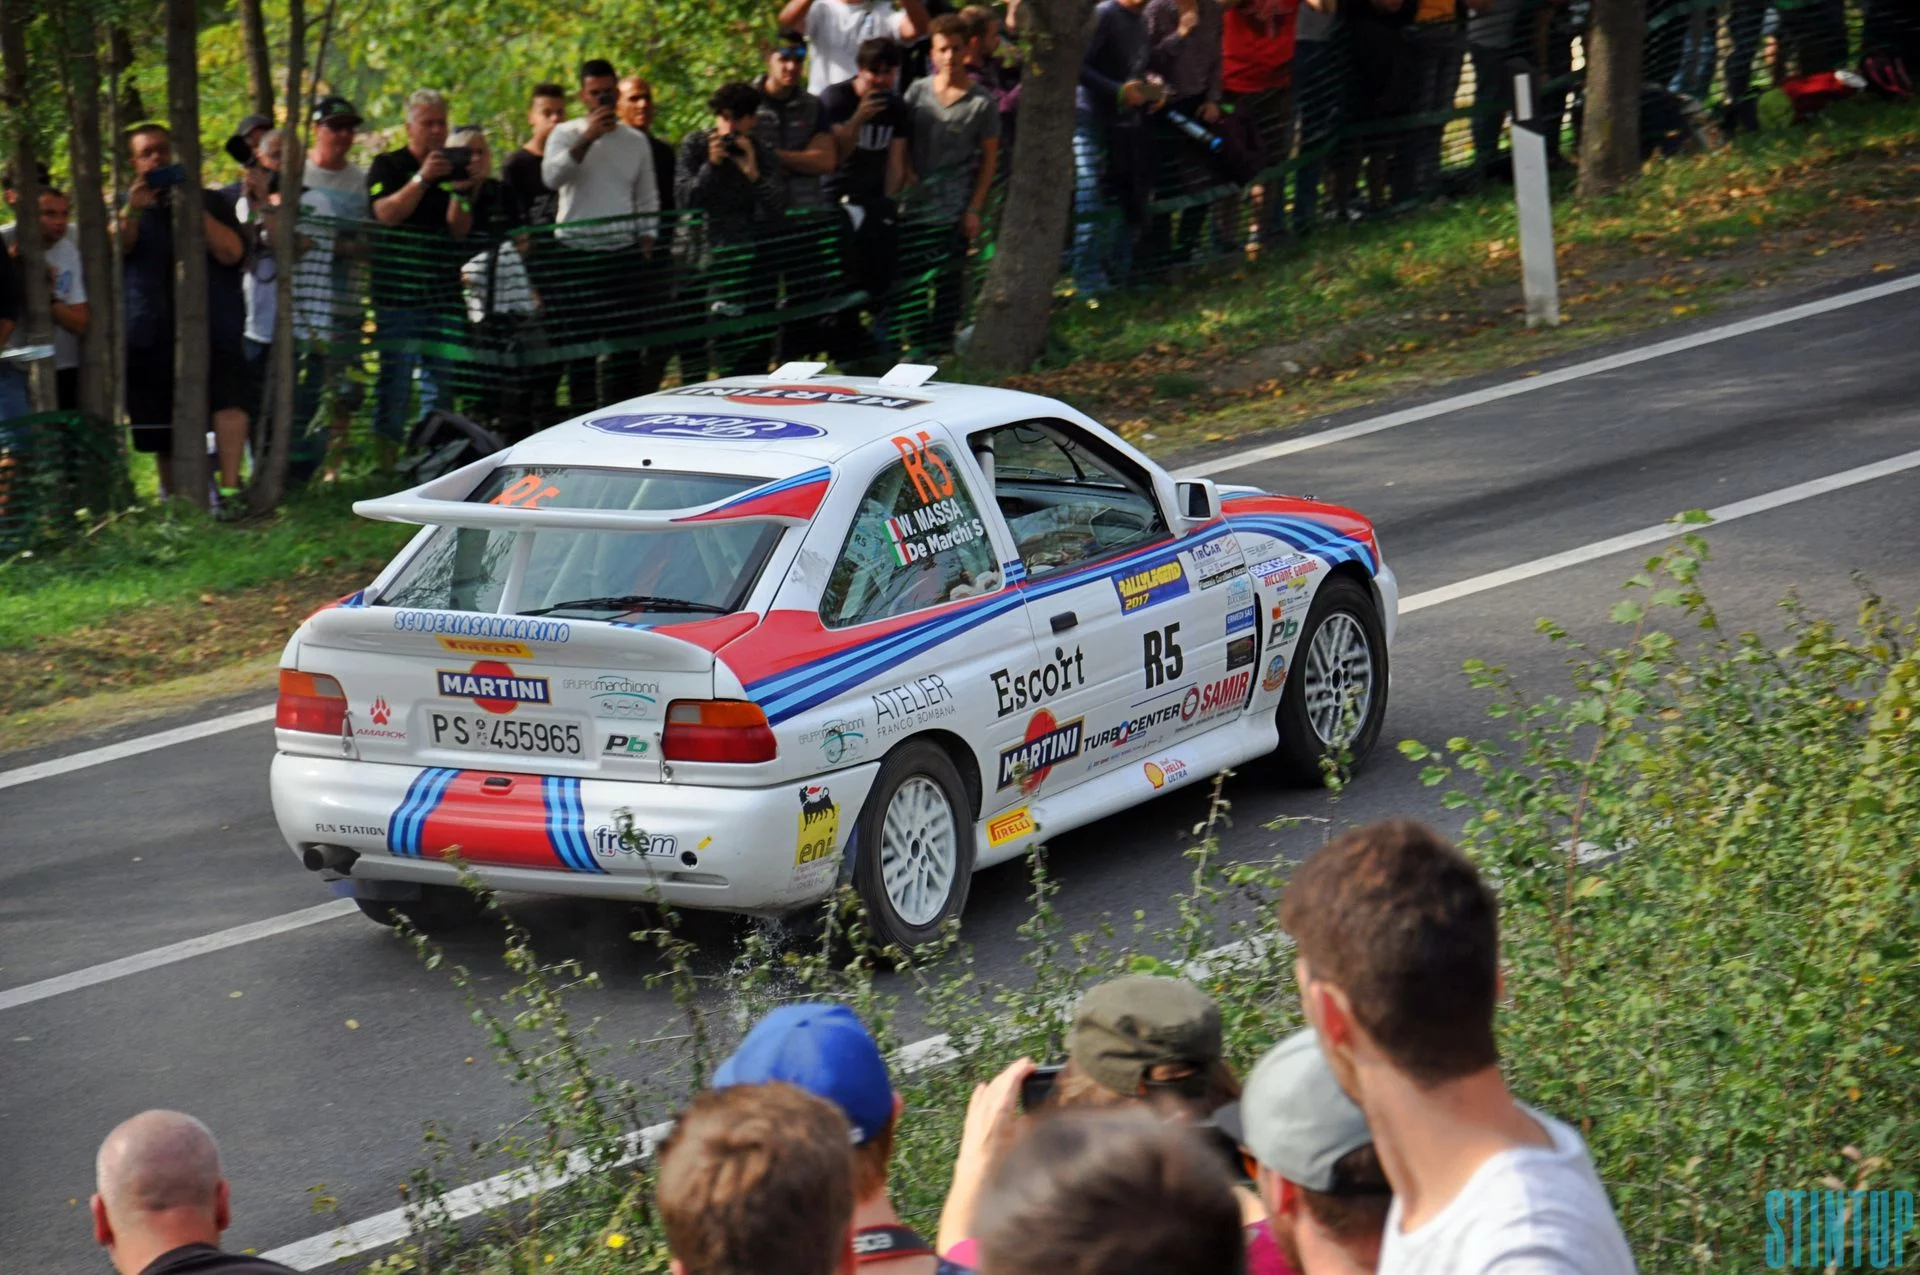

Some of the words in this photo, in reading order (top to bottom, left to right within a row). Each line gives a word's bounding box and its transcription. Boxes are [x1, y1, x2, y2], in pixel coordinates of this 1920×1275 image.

[680, 386, 910, 407] MARTINI
[625, 414, 789, 438] Ford
[891, 431, 954, 504] R5
[895, 514, 917, 538] W.
[913, 498, 964, 532] MASSA
[905, 541, 928, 562] De
[927, 521, 974, 555] Marchi
[971, 518, 984, 538] S
[1124, 593, 1150, 611] 2017
[394, 611, 570, 643] SCUDERIASANMARINO
[1267, 618, 1299, 646] Pb
[1143, 621, 1183, 690] R5
[442, 674, 544, 700] MARTINI
[990, 644, 1085, 718] Escort
[1201, 671, 1249, 712] SAMIR
[871, 674, 953, 725] ATELIER
[356, 728, 407, 740] AMAROK
[432, 714, 470, 745] PS
[490, 720, 580, 755] 455965
[876, 717, 914, 739] FRANCO
[916, 704, 957, 724] BOMBANA
[606, 734, 649, 754] Pb
[1002, 726, 1079, 783] MARTINI
[315, 823, 336, 833] FUN
[339, 824, 386, 836] STATION
[990, 812, 1031, 842] PIRELLI
